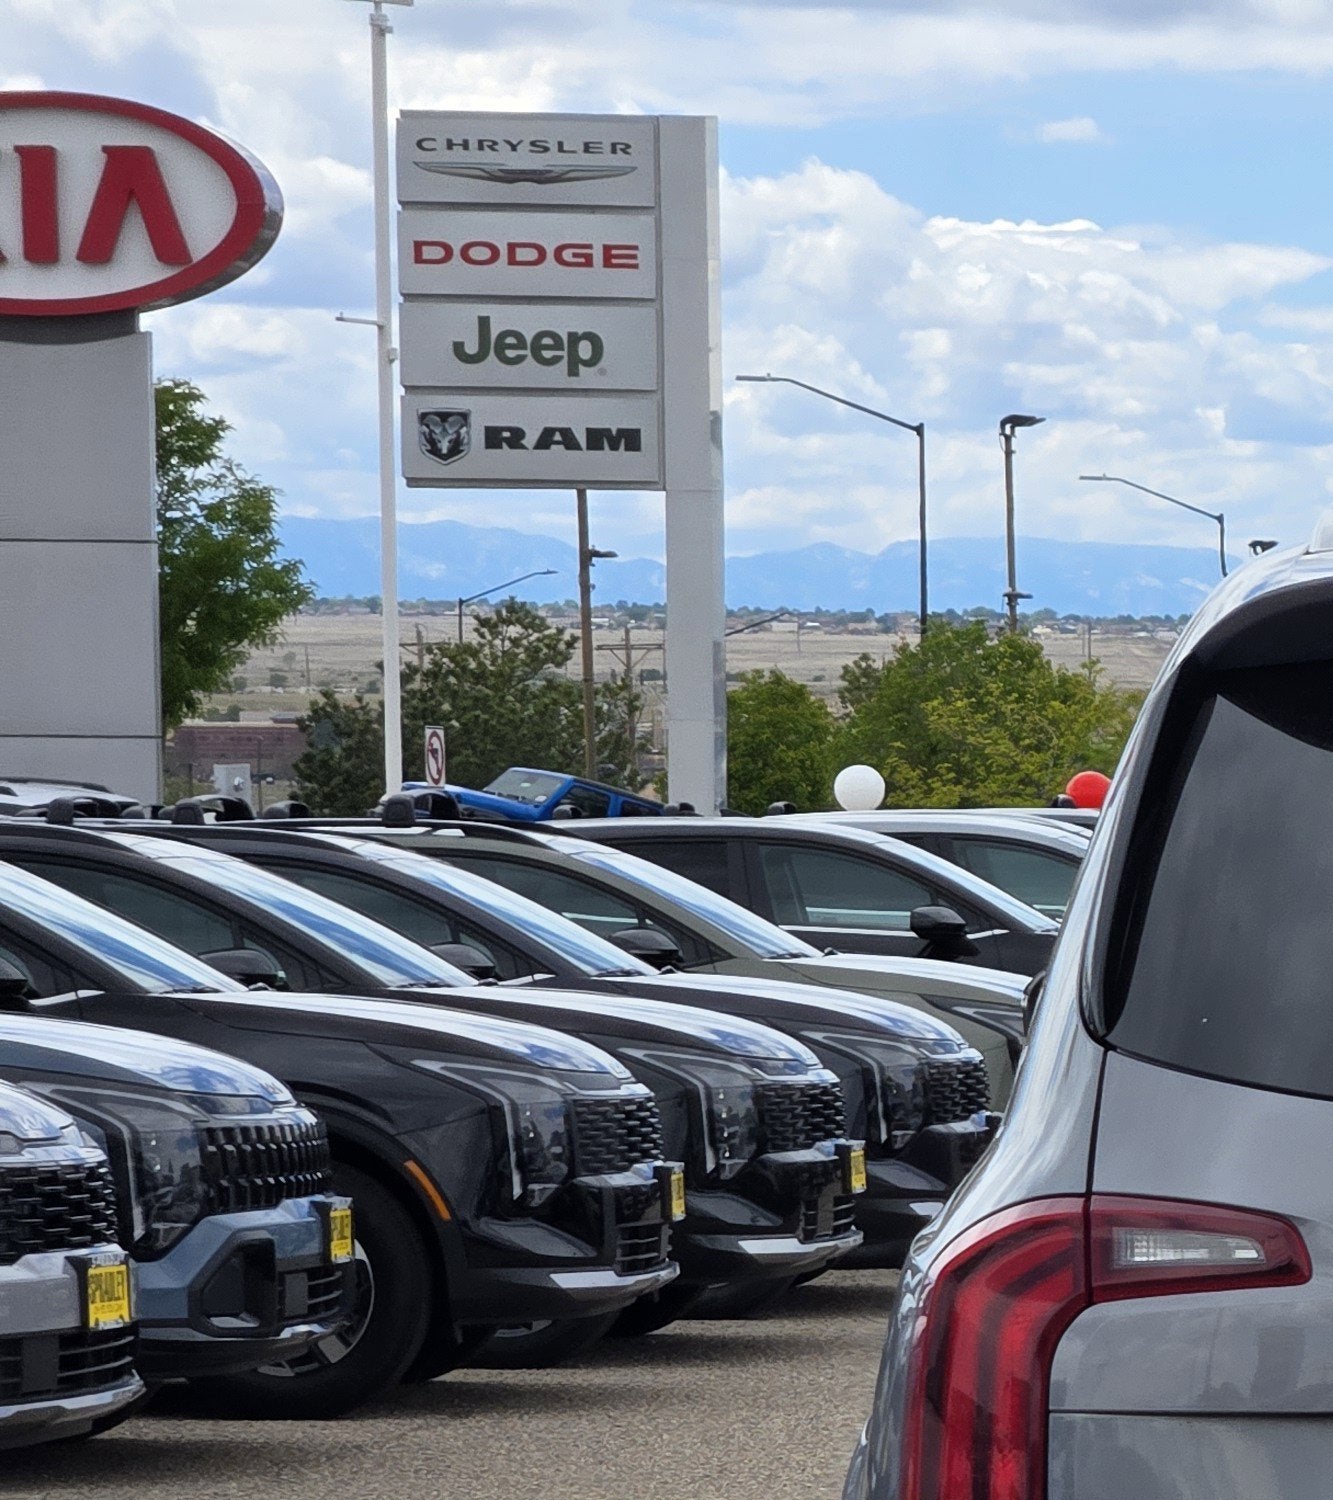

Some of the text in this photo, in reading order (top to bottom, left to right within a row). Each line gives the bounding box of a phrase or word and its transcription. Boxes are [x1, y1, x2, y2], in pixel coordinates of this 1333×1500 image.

[415, 137, 633, 155] CHRYSLER
[0, 144, 194, 264] IA
[413, 240, 640, 270] DODGE
[452, 315, 605, 378] Jeep
[484, 425, 643, 452] RAM
